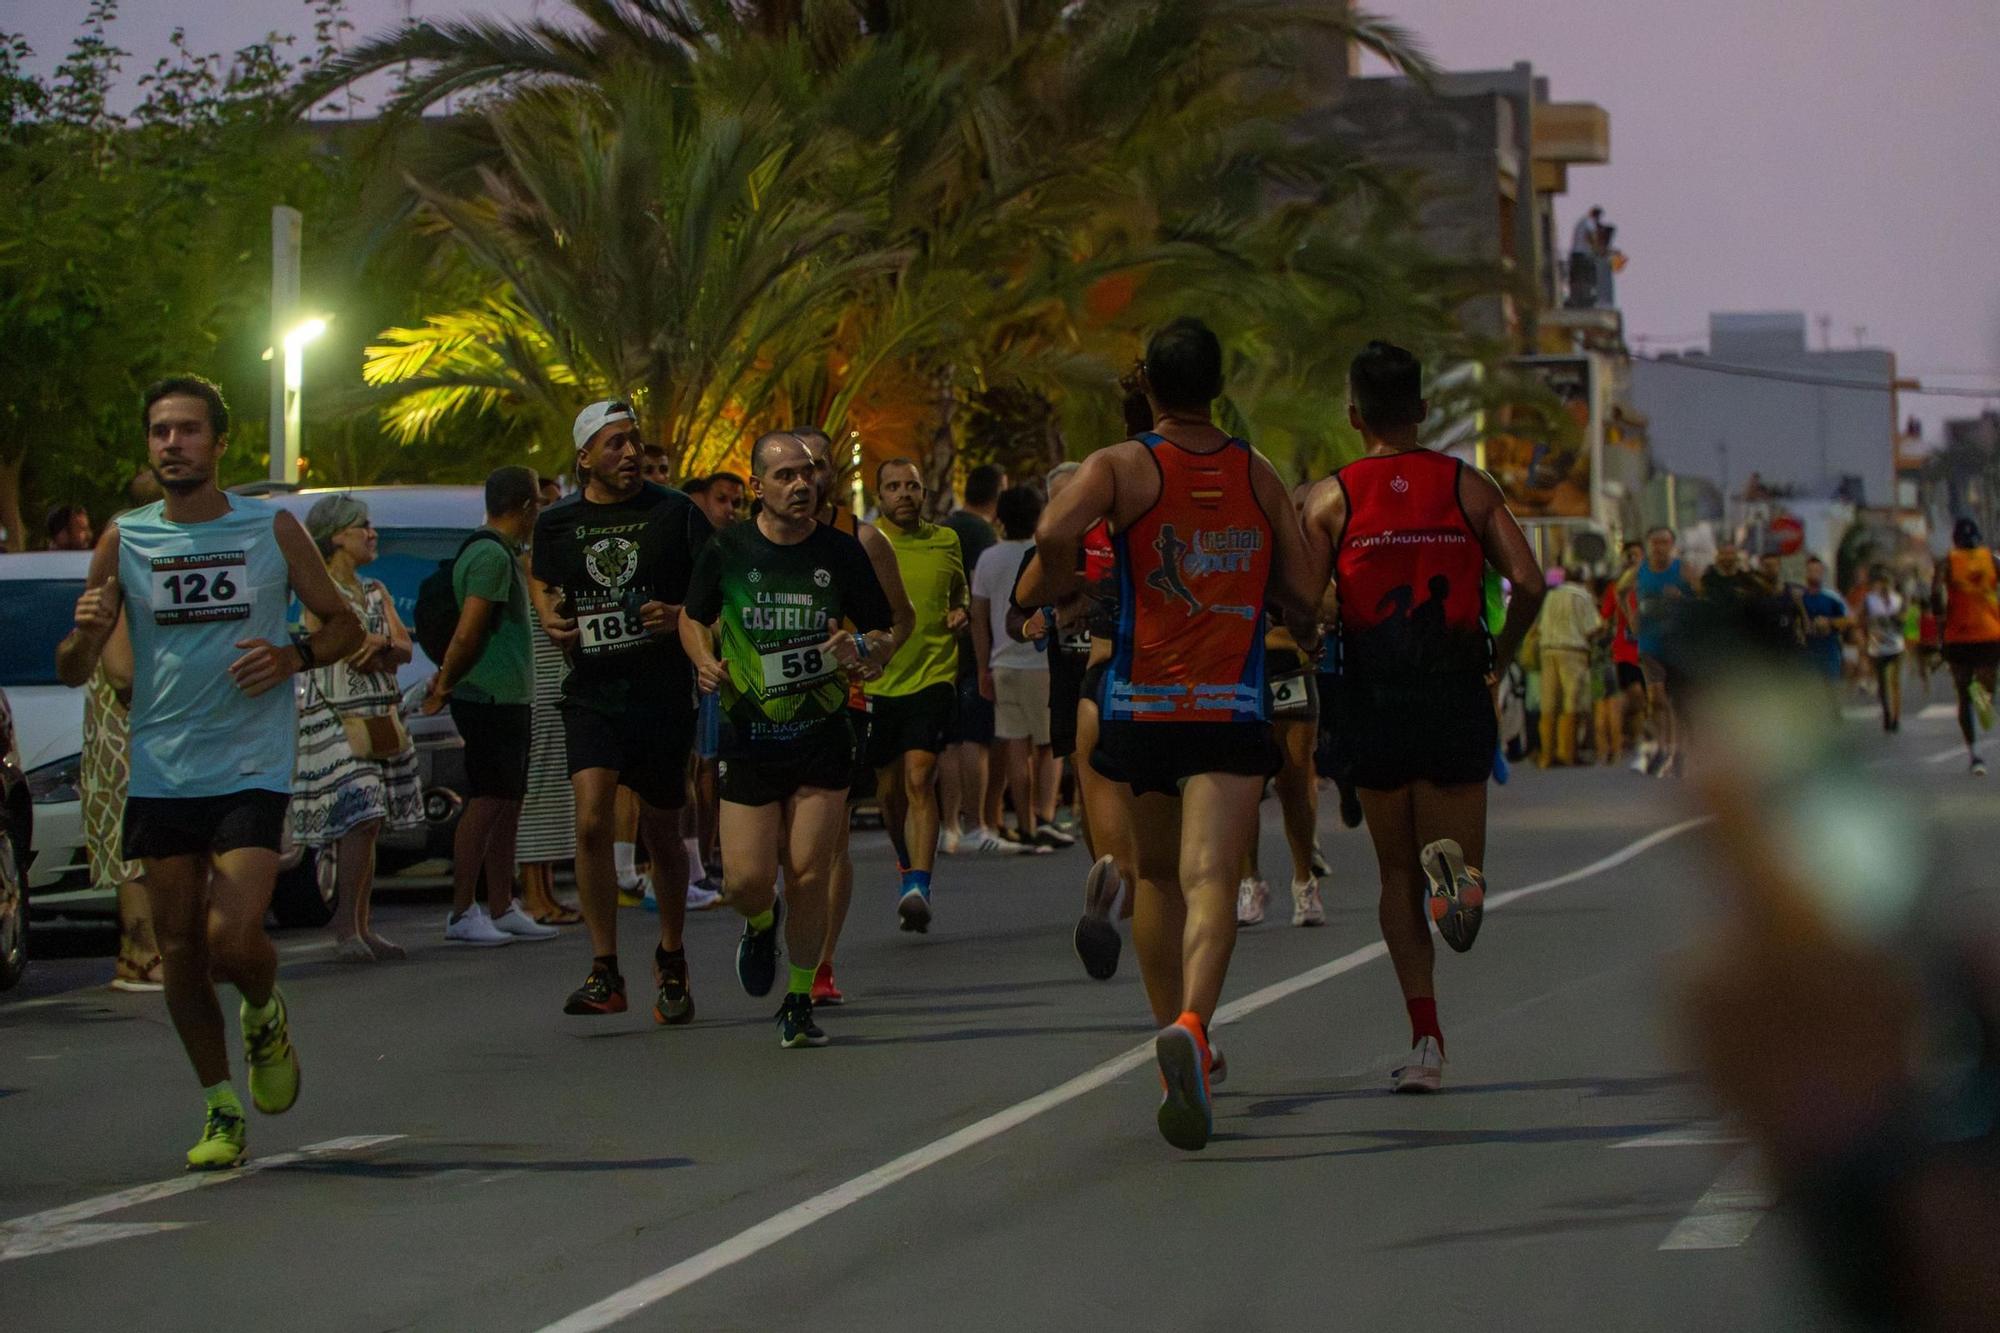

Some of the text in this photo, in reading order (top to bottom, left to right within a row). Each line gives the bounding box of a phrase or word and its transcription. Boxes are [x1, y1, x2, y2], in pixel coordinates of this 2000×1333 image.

[163, 571, 236, 604] 126
[774, 593, 813, 606] RUNNING
[587, 615, 643, 641] 188
[782, 649, 823, 678] 58
